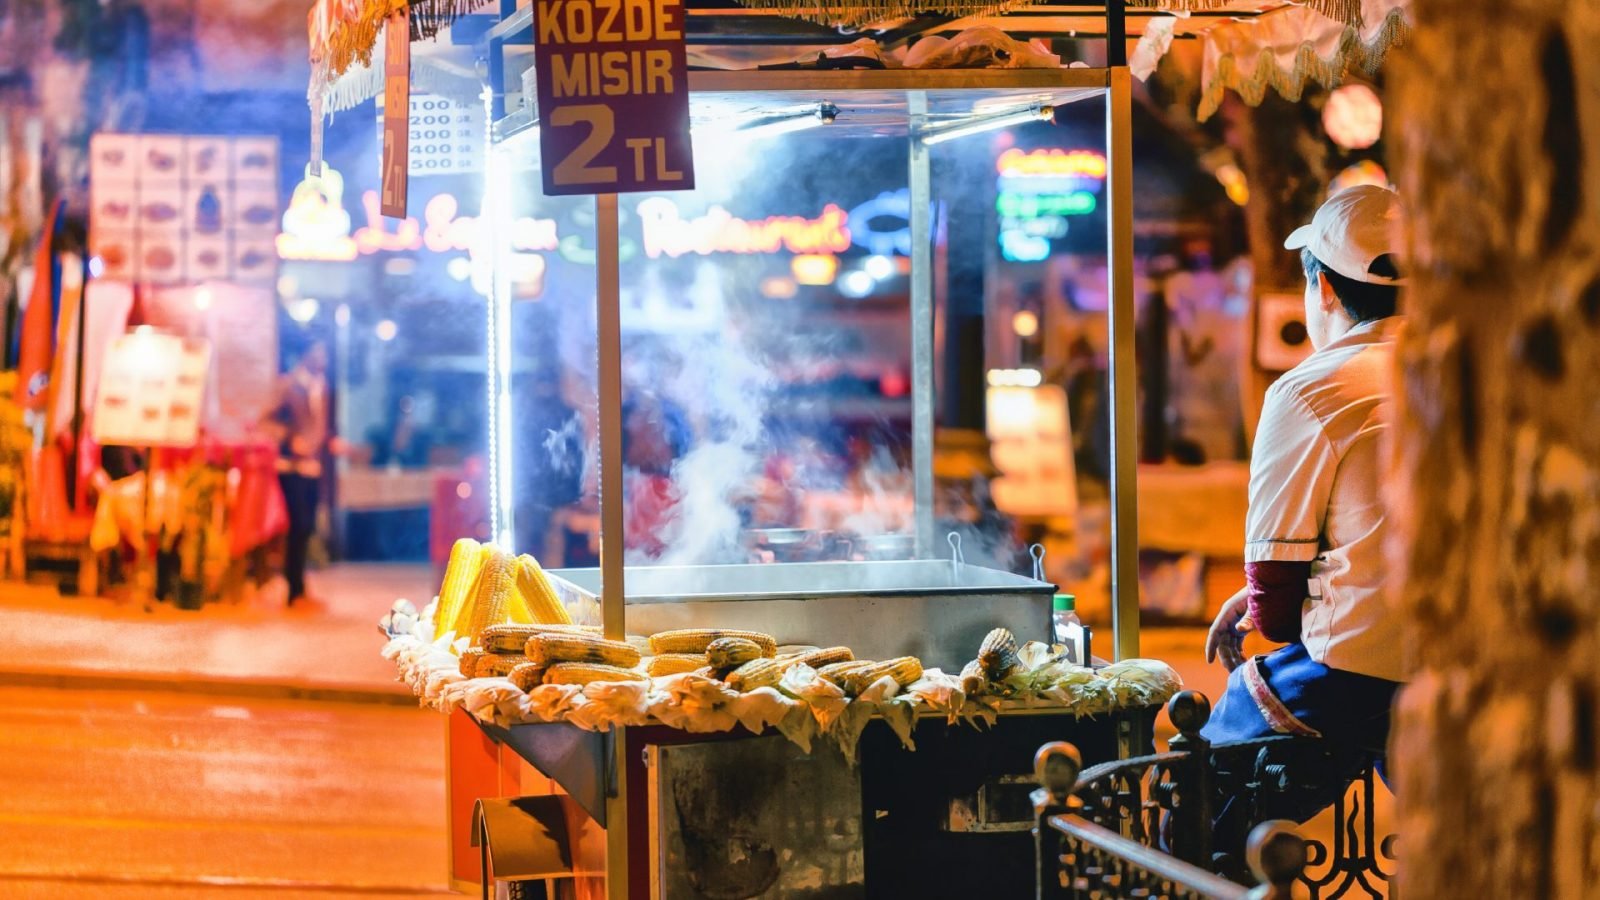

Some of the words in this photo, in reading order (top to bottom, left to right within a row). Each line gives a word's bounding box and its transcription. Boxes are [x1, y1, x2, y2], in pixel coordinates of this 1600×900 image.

[551, 50, 674, 97] MISIR
[410, 100, 449, 110] 100
[410, 115, 450, 125] 200
[410, 129, 450, 139] 300
[410, 144, 451, 154] 400
[551, 104, 617, 185] 2
[626, 137, 683, 182] TL
[382, 130, 394, 206] 2
[411, 158, 452, 169] 500
